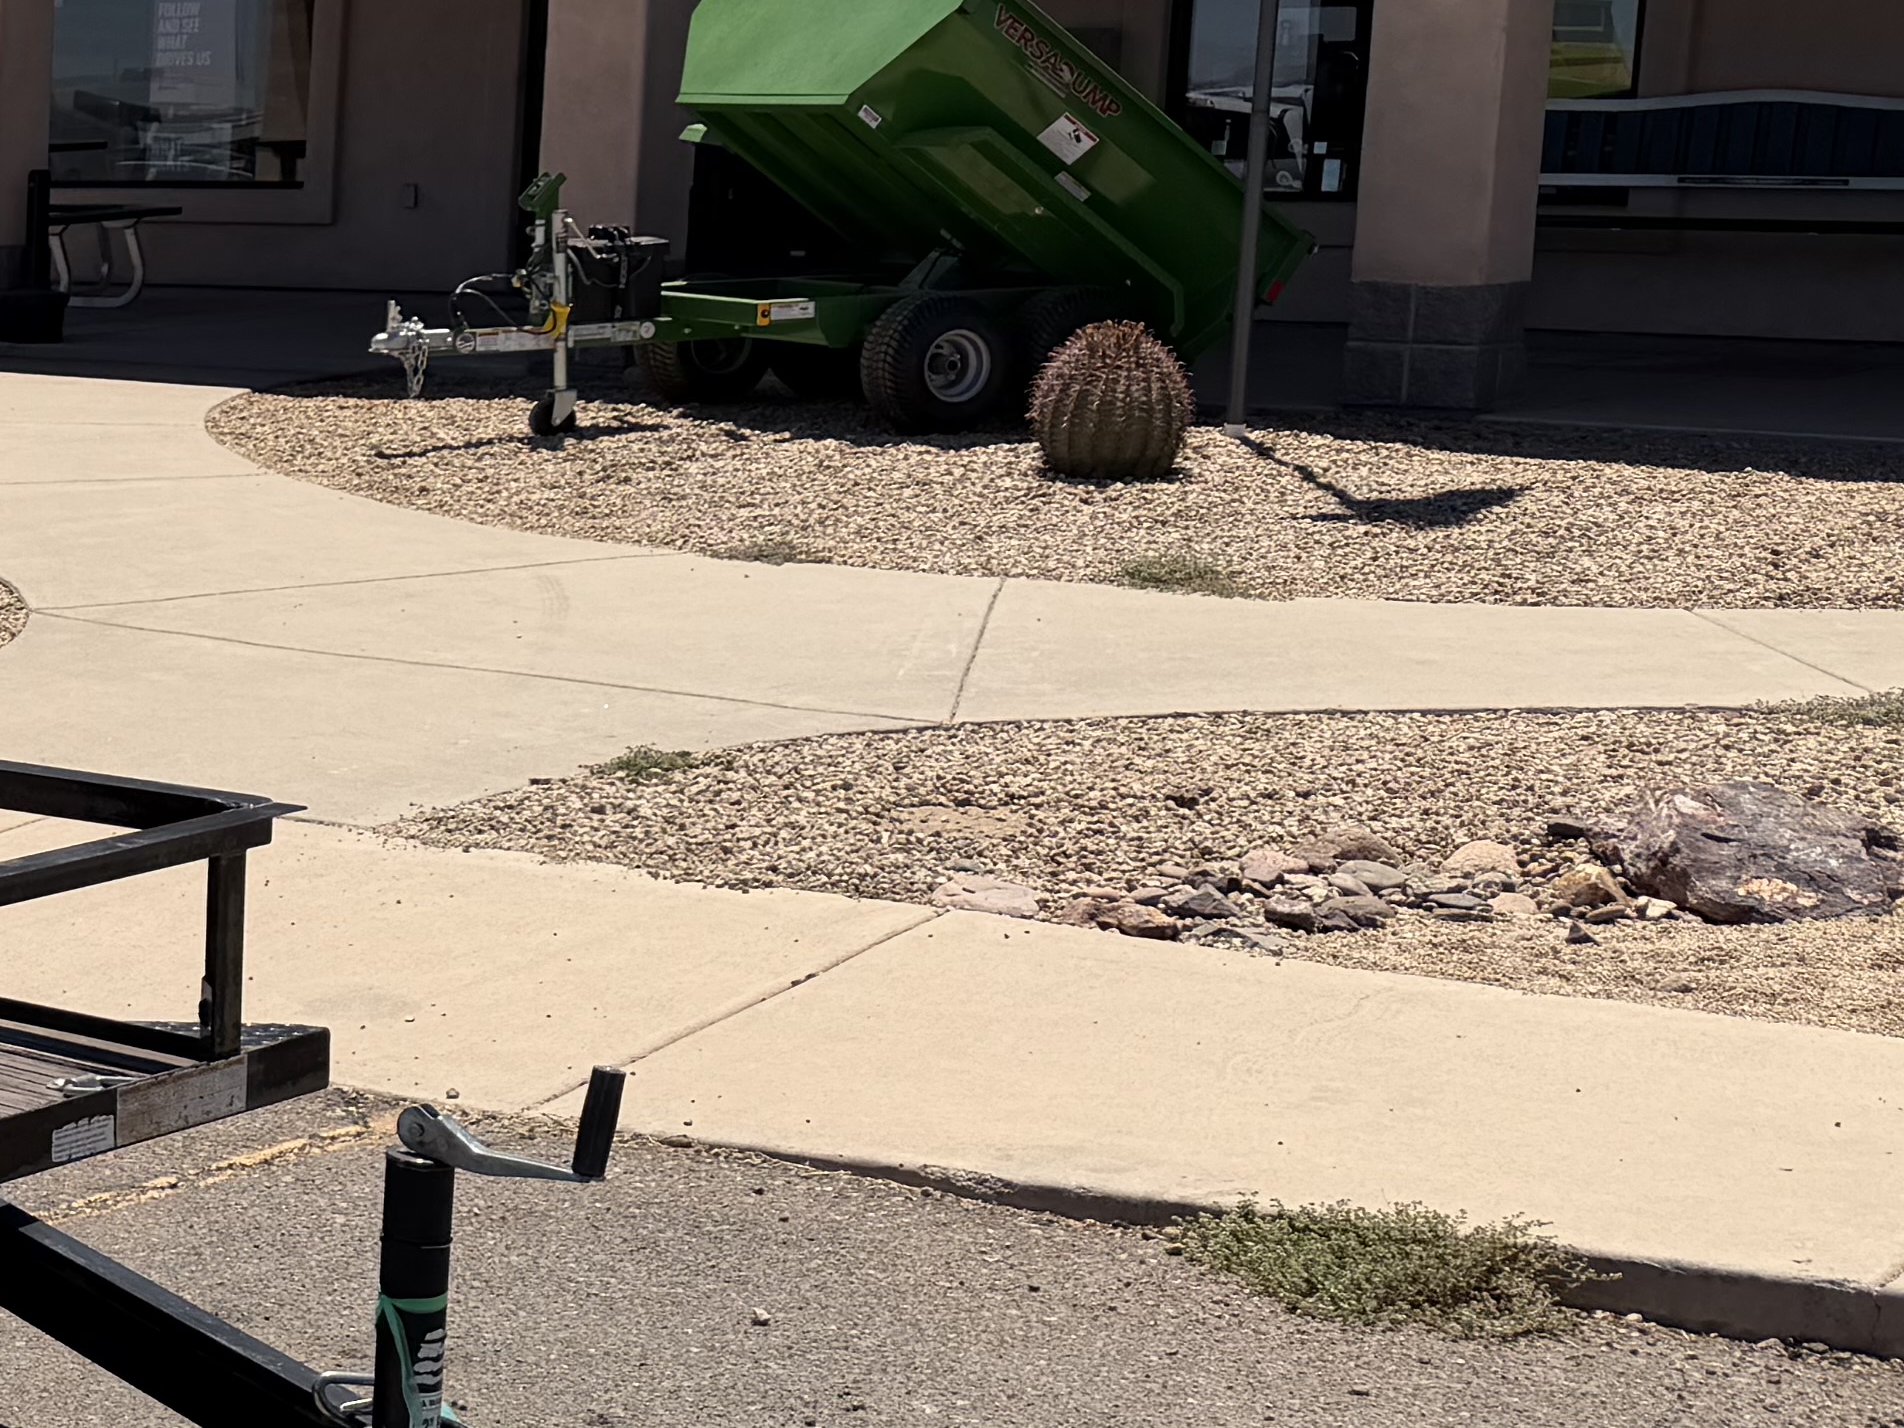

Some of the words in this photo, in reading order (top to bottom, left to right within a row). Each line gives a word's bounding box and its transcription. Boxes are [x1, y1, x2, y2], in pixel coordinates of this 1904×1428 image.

[159, 2, 200, 17] FOLLOW
[158, 18, 181, 33] AND
[182, 17, 200, 33] SEE
[158, 34, 188, 50] WHAT
[195, 50, 211, 66] US
